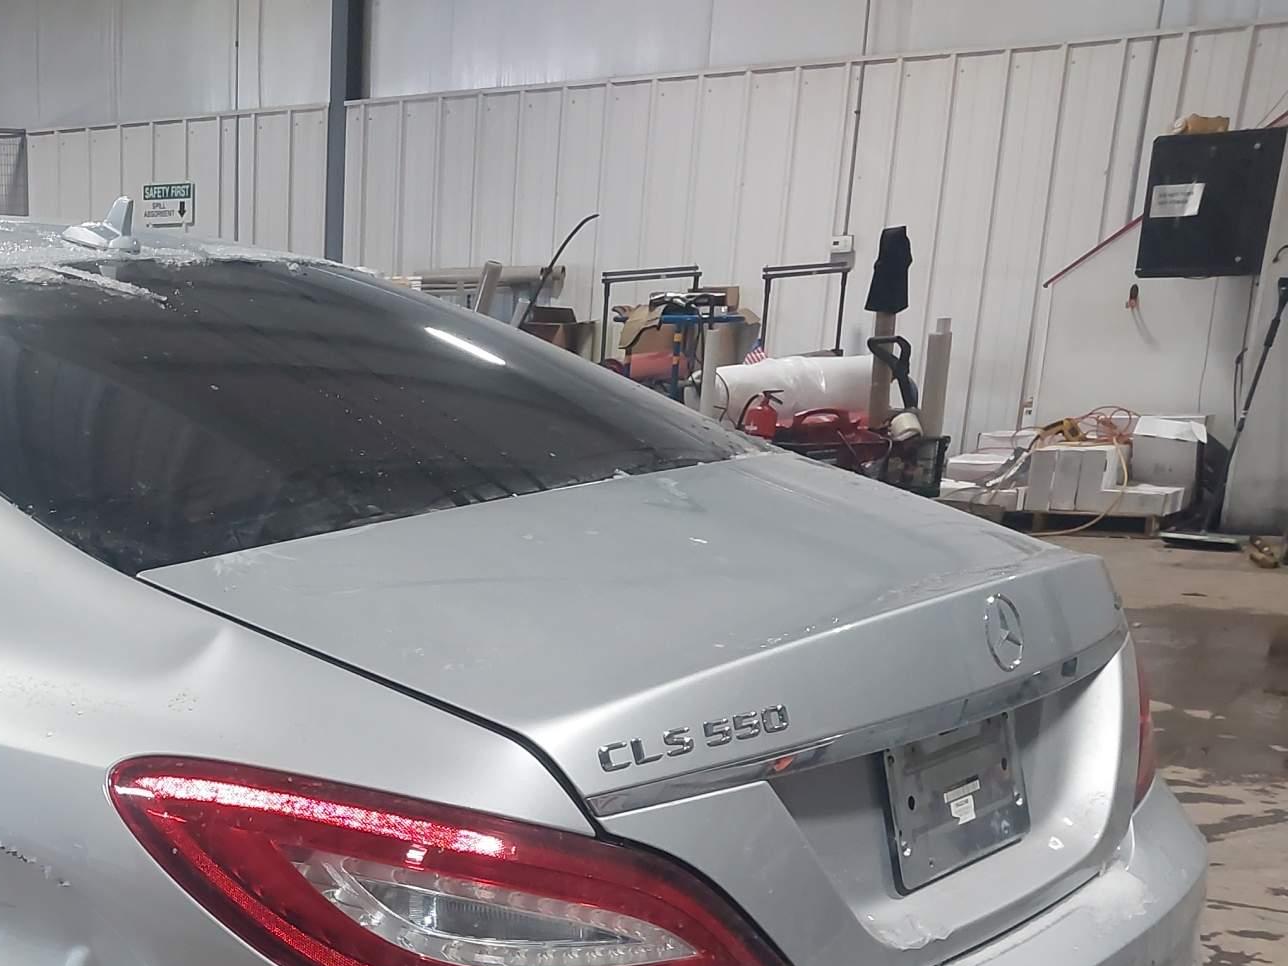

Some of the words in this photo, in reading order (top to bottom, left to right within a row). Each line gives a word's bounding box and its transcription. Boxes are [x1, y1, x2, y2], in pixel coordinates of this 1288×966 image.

[144, 186, 170, 198] SAFETY
[171, 185, 190, 197] FIRST
[598, 727, 694, 772] CLS
[703, 704, 789, 747] 550
